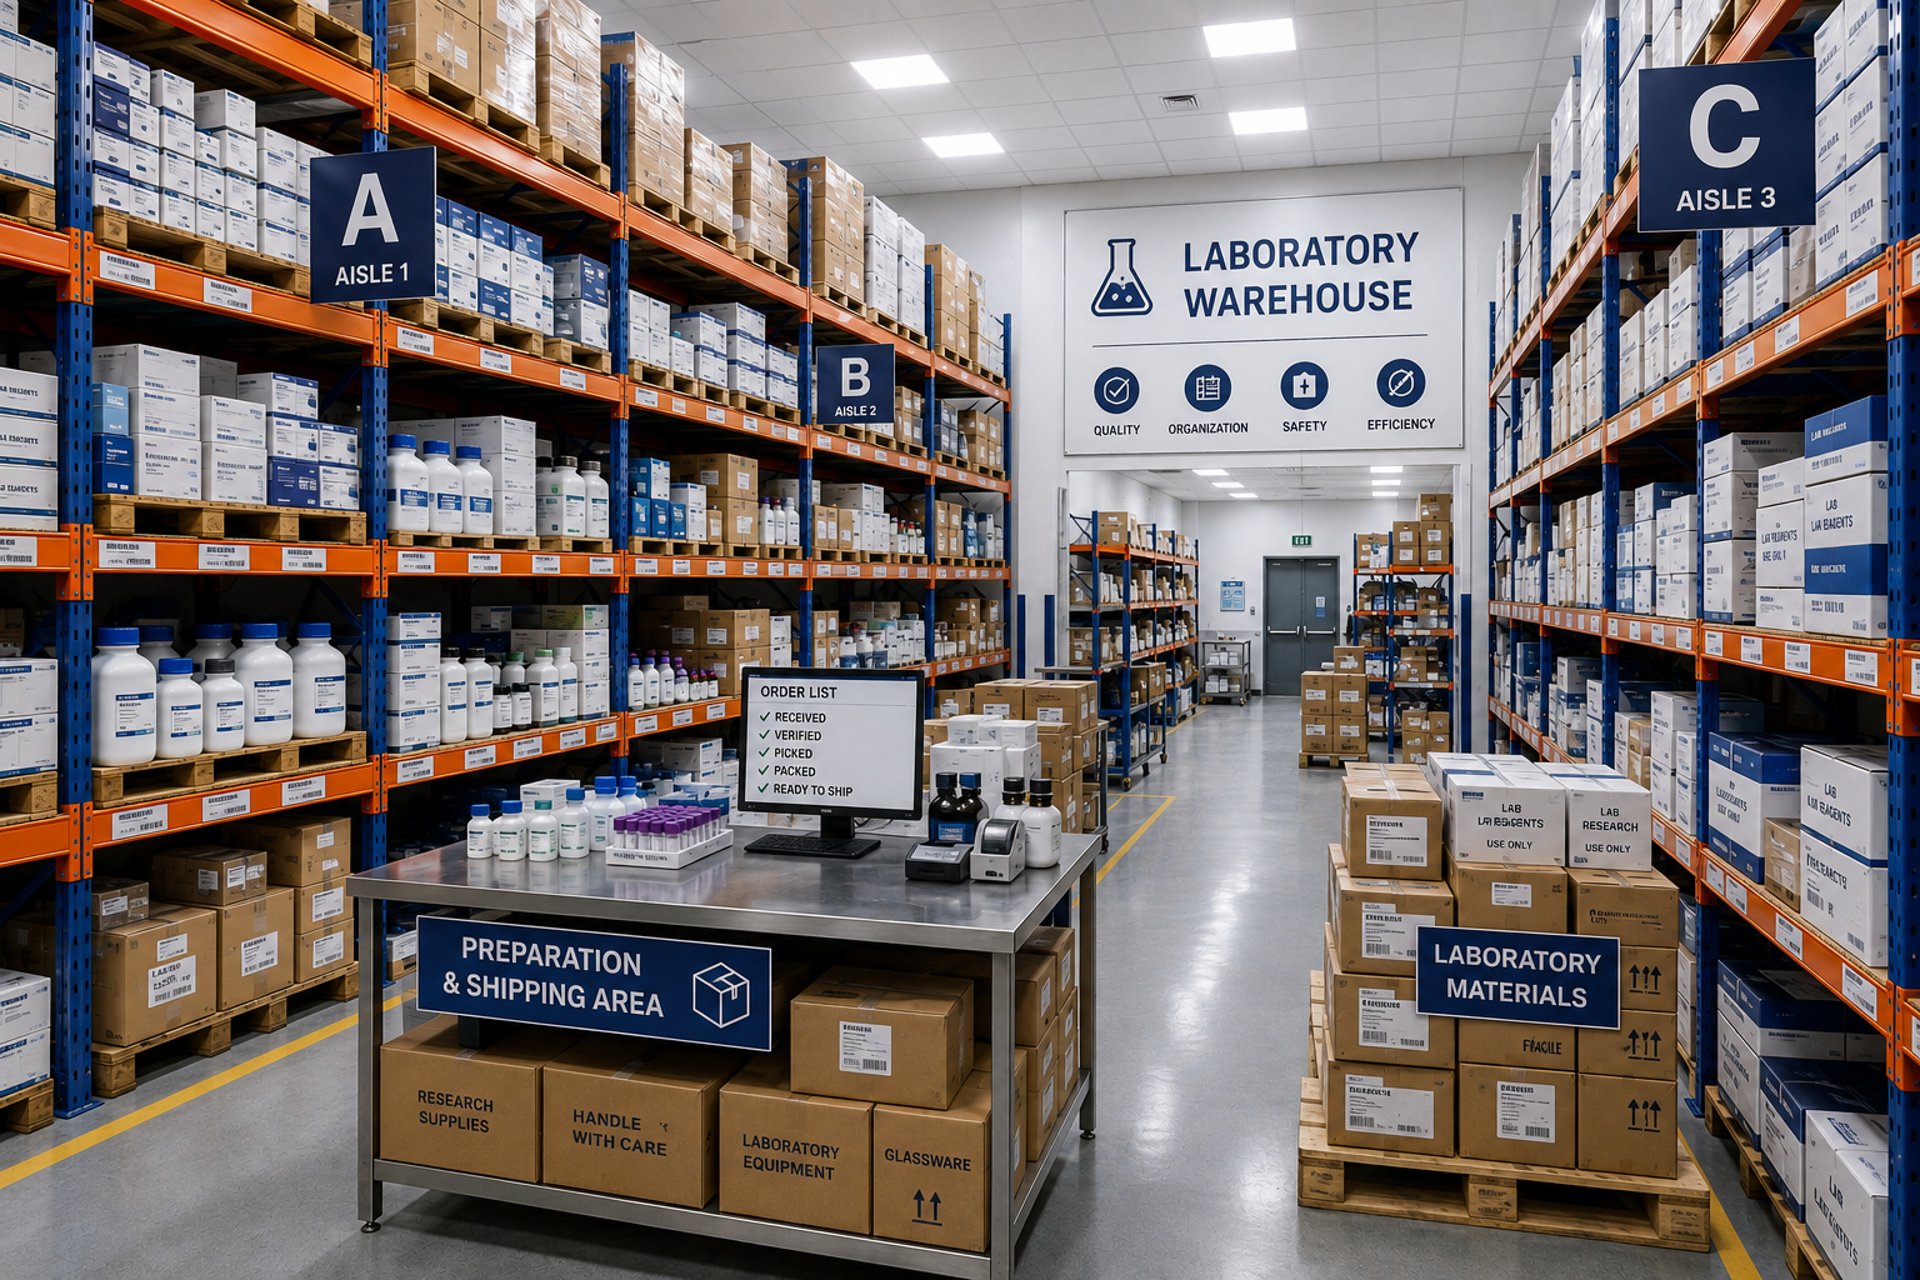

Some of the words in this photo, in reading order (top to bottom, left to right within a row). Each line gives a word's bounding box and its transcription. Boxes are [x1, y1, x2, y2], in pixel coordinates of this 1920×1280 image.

[1690, 84, 1760, 169] C
[342, 172, 399, 246] A
[1676, 187, 1752, 212] AISLE
[1760, 187, 1776, 209] 3
[1184, 231, 1419, 272] LABORATORY
[335, 263, 393, 286] AISLE
[400, 262, 408, 281] 1
[1184, 279, 1413, 318] WAREHOUSE
[841, 357, 871, 397] B
[834, 405, 867, 417] AISLE
[869, 405, 877, 416] 2
[1094, 423, 1141, 437] QUALITY
[1168, 422, 1249, 434] ORGANIZATION
[1283, 420, 1328, 432] SAFETY
[1367, 418, 1436, 431] EFFICIENCY
[760, 685, 805, 698] ORDER
[809, 686, 838, 699] LIST
[775, 712, 826, 723] RECEIVED
[774, 729, 822, 741] VERIFIED
[774, 748, 813, 759] PICKED
[774, 766, 816, 777] PACKED
[773, 784, 809, 795] READY
[811, 785, 826, 796] TO
[828, 786, 853, 797] SHIP
[1501, 803, 1522, 814] LAB
[1600, 807, 1620, 817] LAB
[1582, 820, 1639, 832] RESEARCH
[1486, 839, 1505, 849] USE
[1507, 840, 1533, 850] ONLY
[1585, 843, 1604, 853] USE
[1606, 844, 1631, 854] ONLY
[462, 936, 641, 976] PREPARATION
[1434, 943, 1602, 975] LABORATORY
[443, 971, 460, 995] &
[466, 972, 586, 1009] SHIPPING
[592, 987, 665, 1018] AREA
[1447, 977, 1588, 1009] MATERIALS
[418, 1090, 494, 1113] RESEARCH
[419, 1110, 490, 1133] SUPPLIES
[573, 1108, 641, 1131] HANDLE
[572, 1129, 615, 1149] WITH
[620, 1136, 668, 1157] CARE
[743, 1133, 840, 1160] LABORATORY
[743, 1155, 835, 1181] EQUIPMENT
[884, 1148, 972, 1172] GLASSWARE
